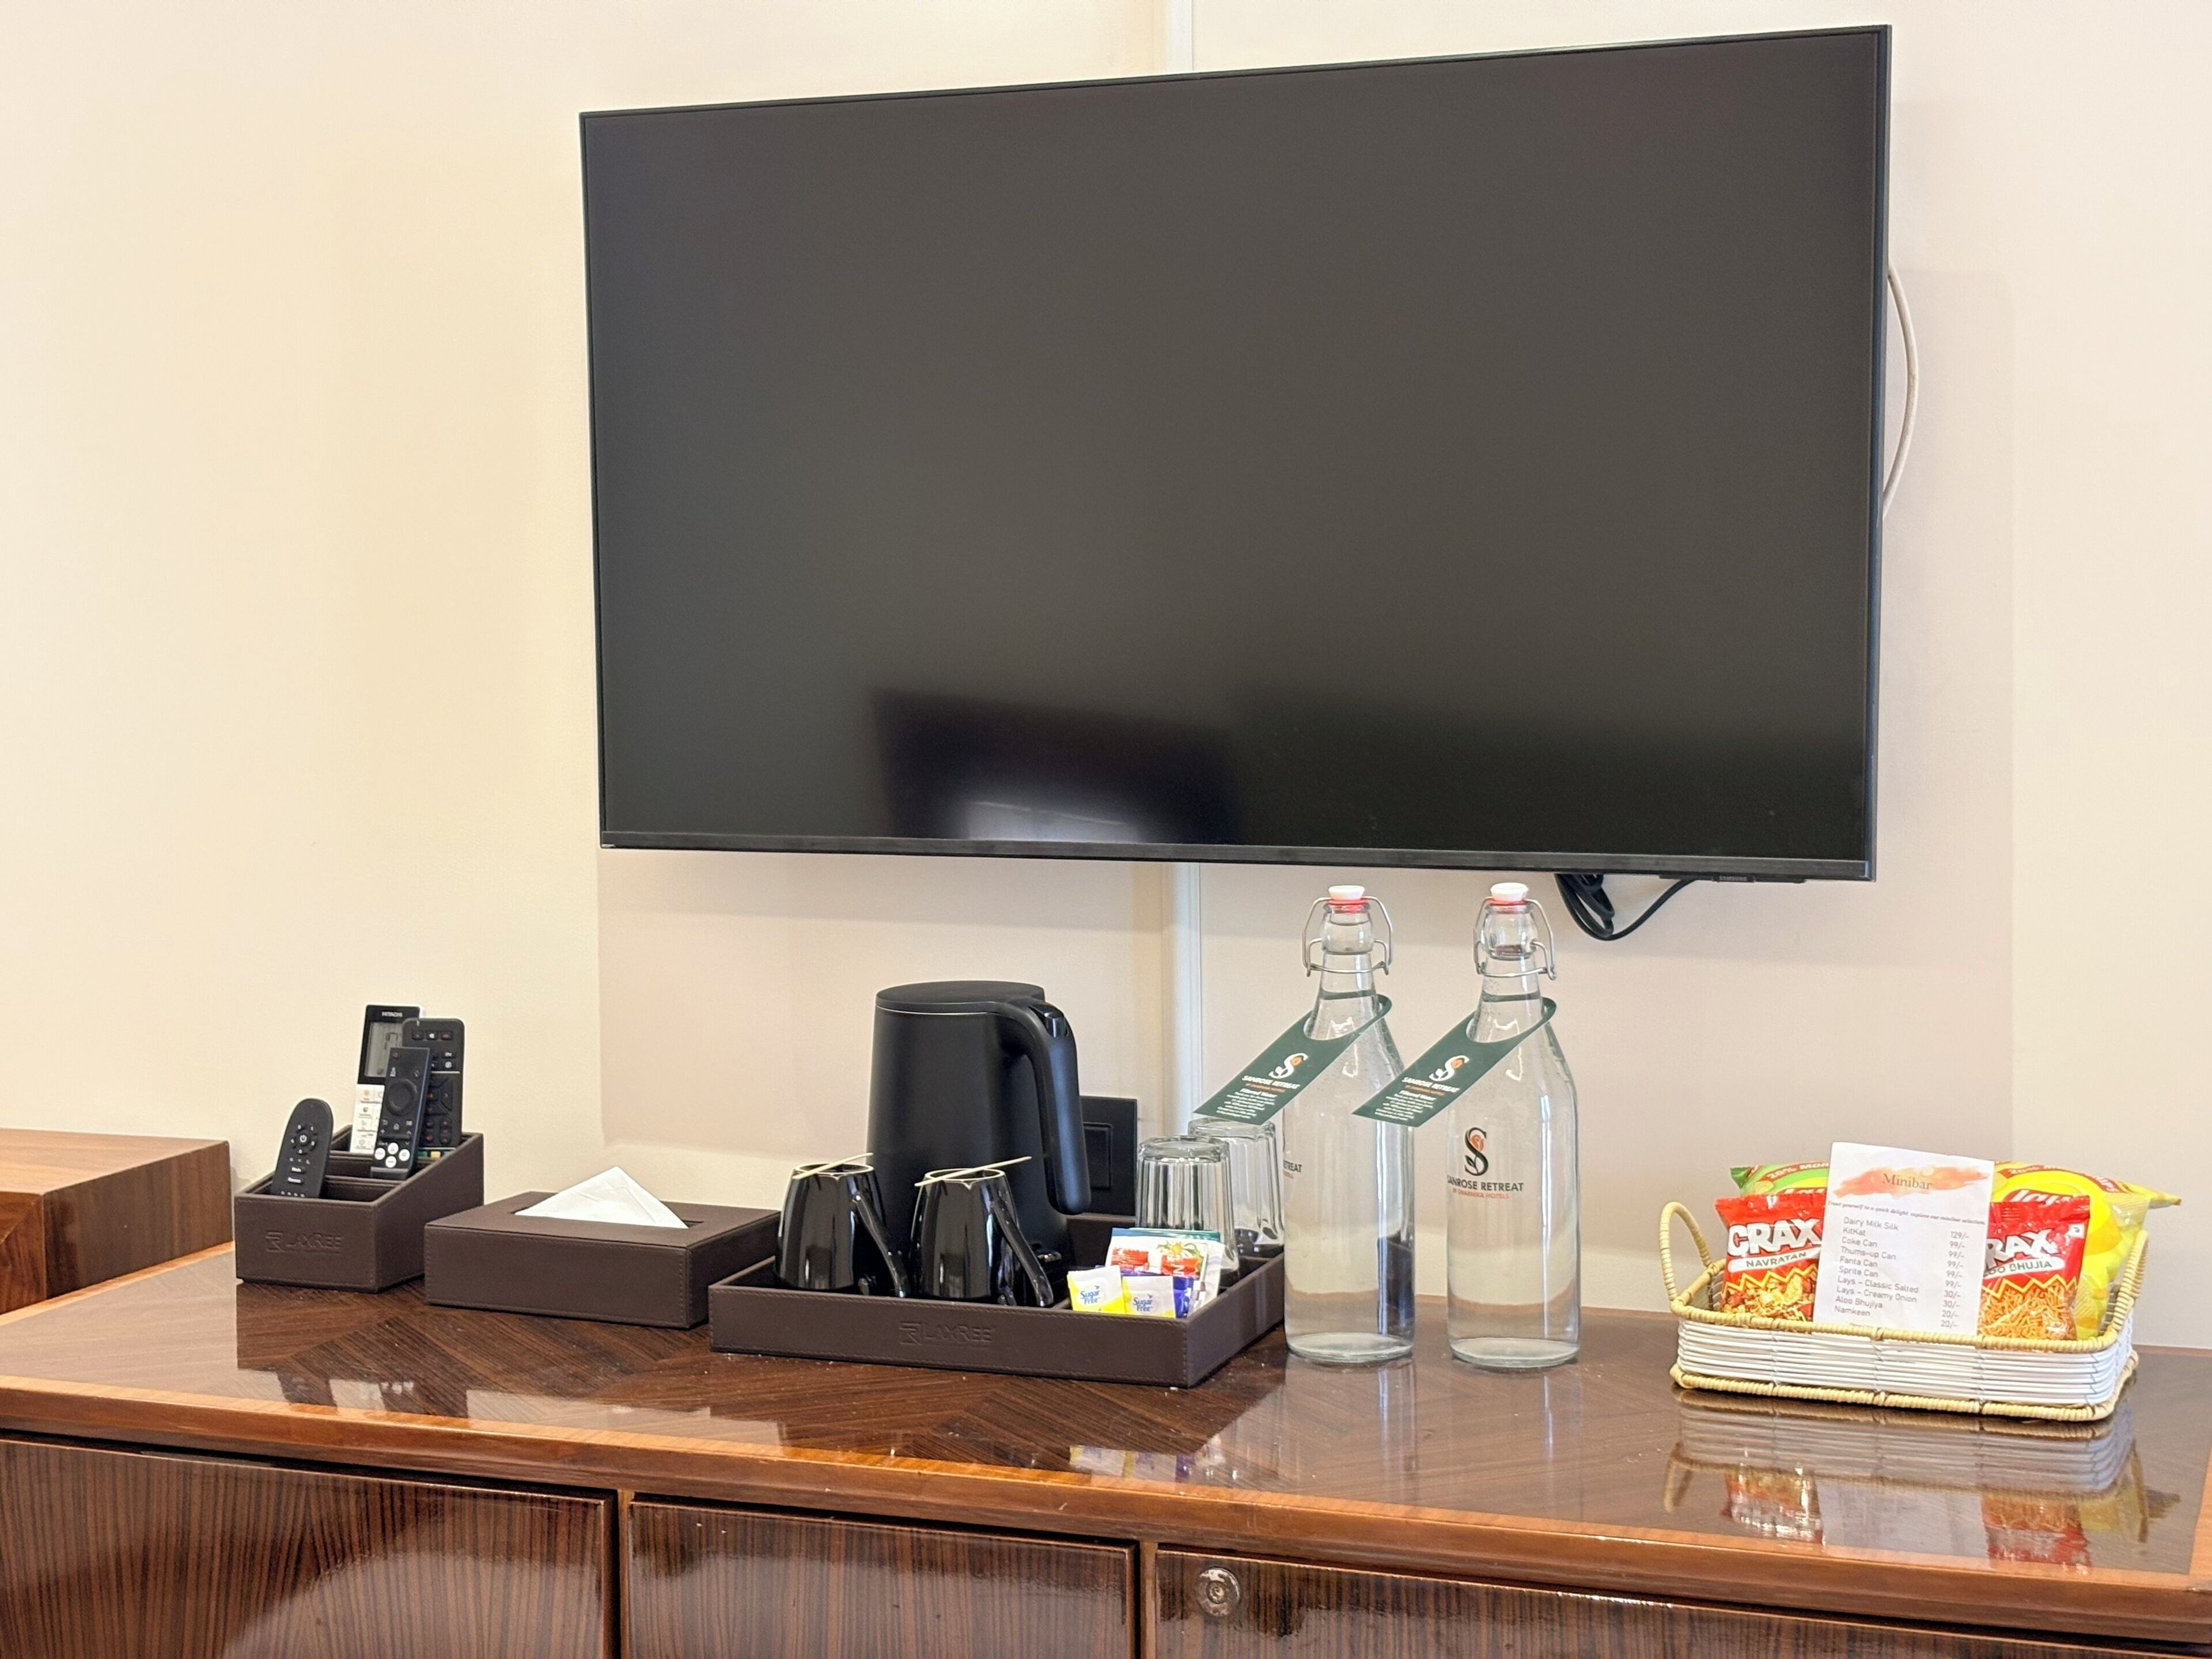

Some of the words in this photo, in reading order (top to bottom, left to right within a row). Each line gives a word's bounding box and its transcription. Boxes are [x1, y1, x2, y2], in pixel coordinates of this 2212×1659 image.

[1481, 1181, 1524, 1191] RETREAT
[1882, 1173, 1933, 1190] Minibar
[1728, 1218, 1822, 1257] CRAX
[1843, 1227, 1866, 1236] KitKat
[1949, 1240, 1965, 1249] 99/-
[1844, 1217, 1864, 1227] Dairy
[1866, 1219, 1882, 1228] Milk
[1884, 1222, 1899, 1230] Silk
[1950, 1231, 1969, 1240] 129/-
[1841, 1245, 1879, 1259] Thums-up
[1881, 1252, 1896, 1260] Can
[1947, 1260, 1963, 1269] 99/-
[1842, 1236, 1861, 1245] Coke
[1862, 1239, 1877, 1247] Can
[1948, 1251, 1964, 1260] 99/-
[1985, 1228, 2059, 1270] RAX
[1746, 1252, 1806, 1268] NAVRATAN
[1840, 1256, 1861, 1266] Fanta
[1863, 1259, 1878, 1267] Can
[1946, 1270, 1963, 1279] 99/-
[2009, 1261, 2052, 1271] BHUJIA
[1838, 1276, 1855, 1285] Lays
[1865, 1279, 1892, 1290] Classic
[1895, 1283, 1919, 1293] Salted
[1944, 1290, 1961, 1299] 30/-
[1839, 1266, 1862, 1275] Sprite
[1863, 1269, 1878, 1277] Can
[1945, 1280, 1961, 1289] 99/-
[1080, 1290, 1100, 1300] Sugar
[1133, 1297, 1153, 1306] Sugar
[1836, 1286, 1854, 1294] Lays
[1863, 1289, 1893, 1301] Creamy
[1895, 1293, 1917, 1302] Onion
[1942, 1300, 1960, 1309] 30/-
[1834, 1305, 1870, 1316] Namkeen
[1940, 1319, 1957, 1328] 20/-
[1835, 1296, 1853, 1304] Aloo
[1855, 1298, 1883, 1309] Bhujiya
[1941, 1309, 1958, 1319] 20/-
